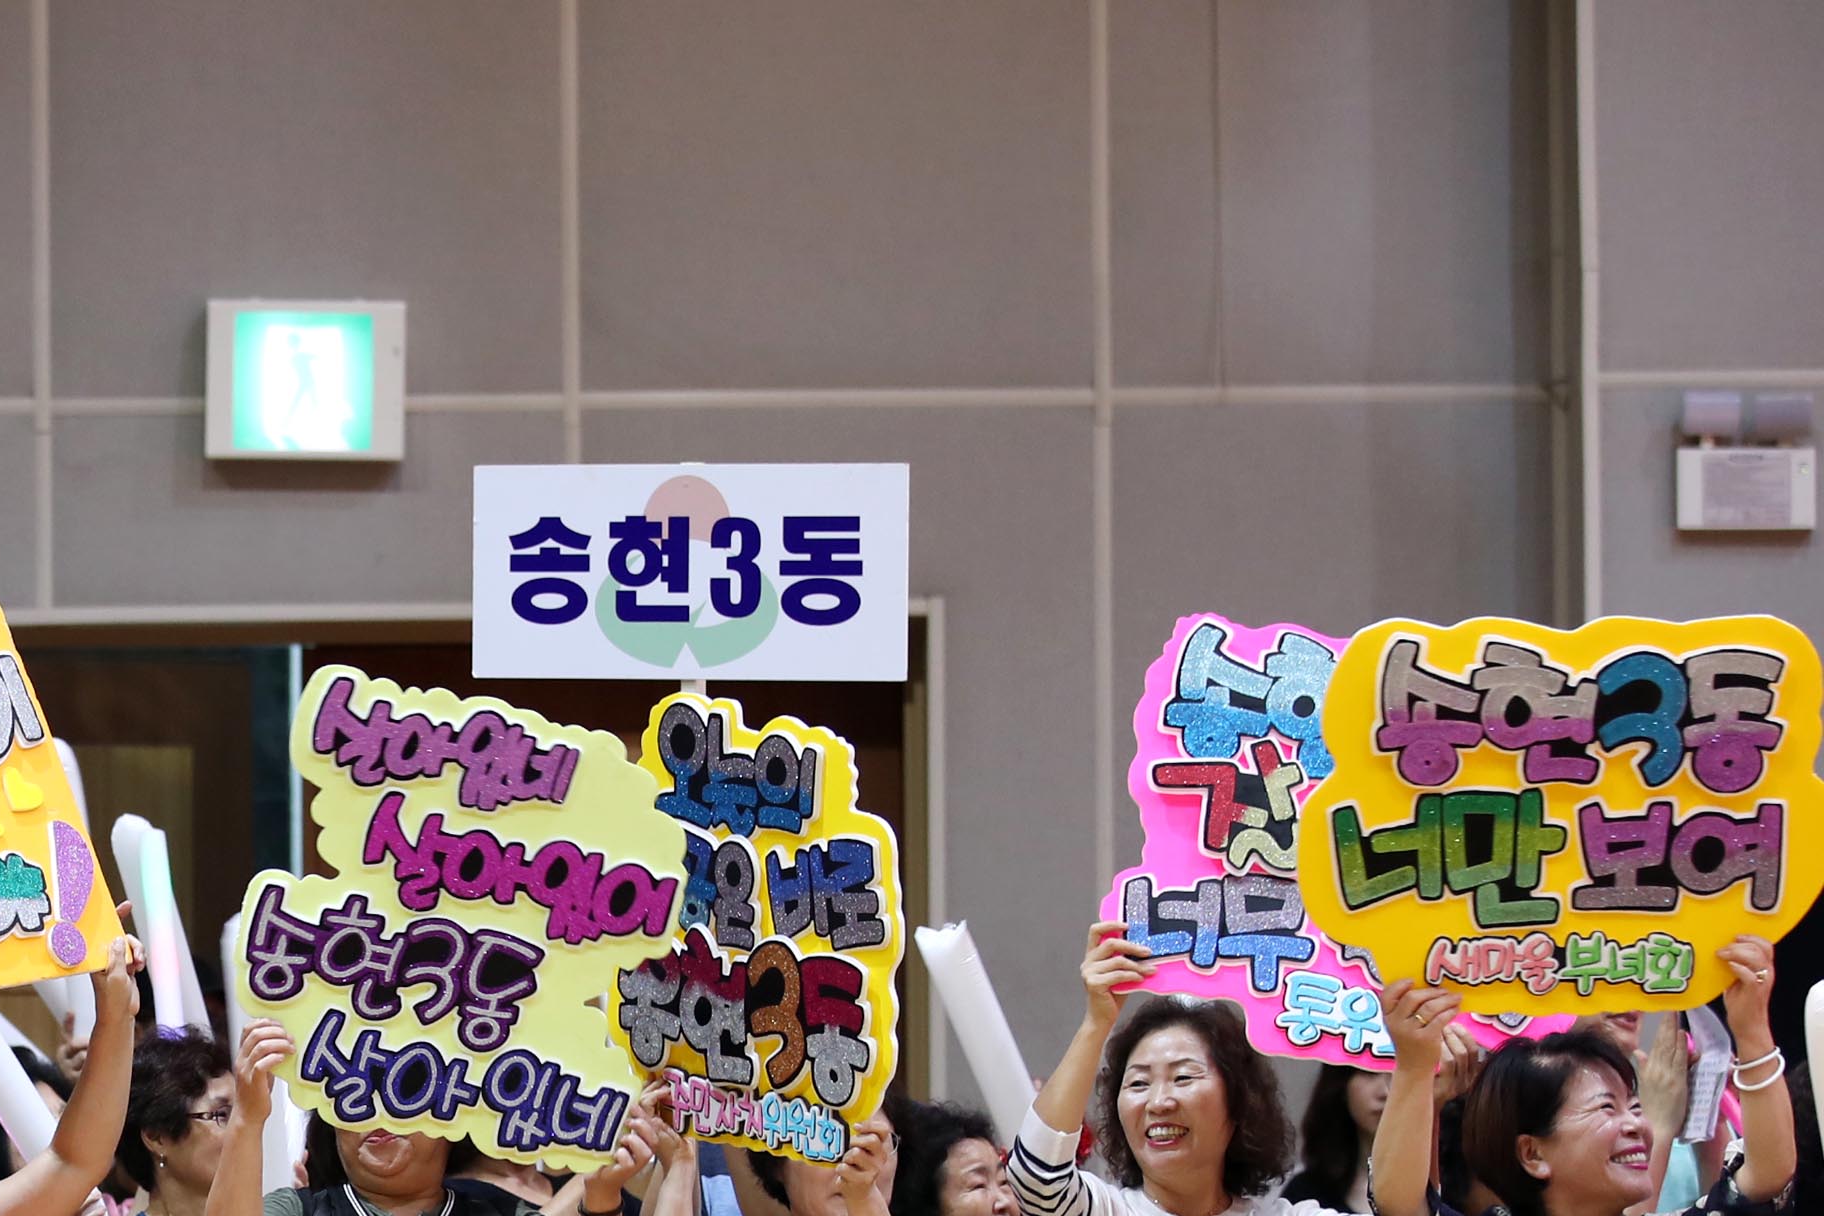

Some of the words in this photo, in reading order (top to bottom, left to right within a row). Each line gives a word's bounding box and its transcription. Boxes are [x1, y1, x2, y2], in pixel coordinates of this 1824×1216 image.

[508, 515, 863, 626] 송현3동
[313, 677, 581, 811] 살아있네
[655, 702, 817, 838] 오늘의
[1377, 639, 1783, 792] 송현3동
[1332, 788, 1568, 928] 너만
[1572, 801, 1784, 911] 보여
[247, 884, 545, 1053] 송현3동
[1123, 875, 1315, 992] 너무
[301, 1009, 630, 1153] 살아있네
[618, 925, 870, 1107] 송현3동
[1280, 973, 1396, 1056] 통우
